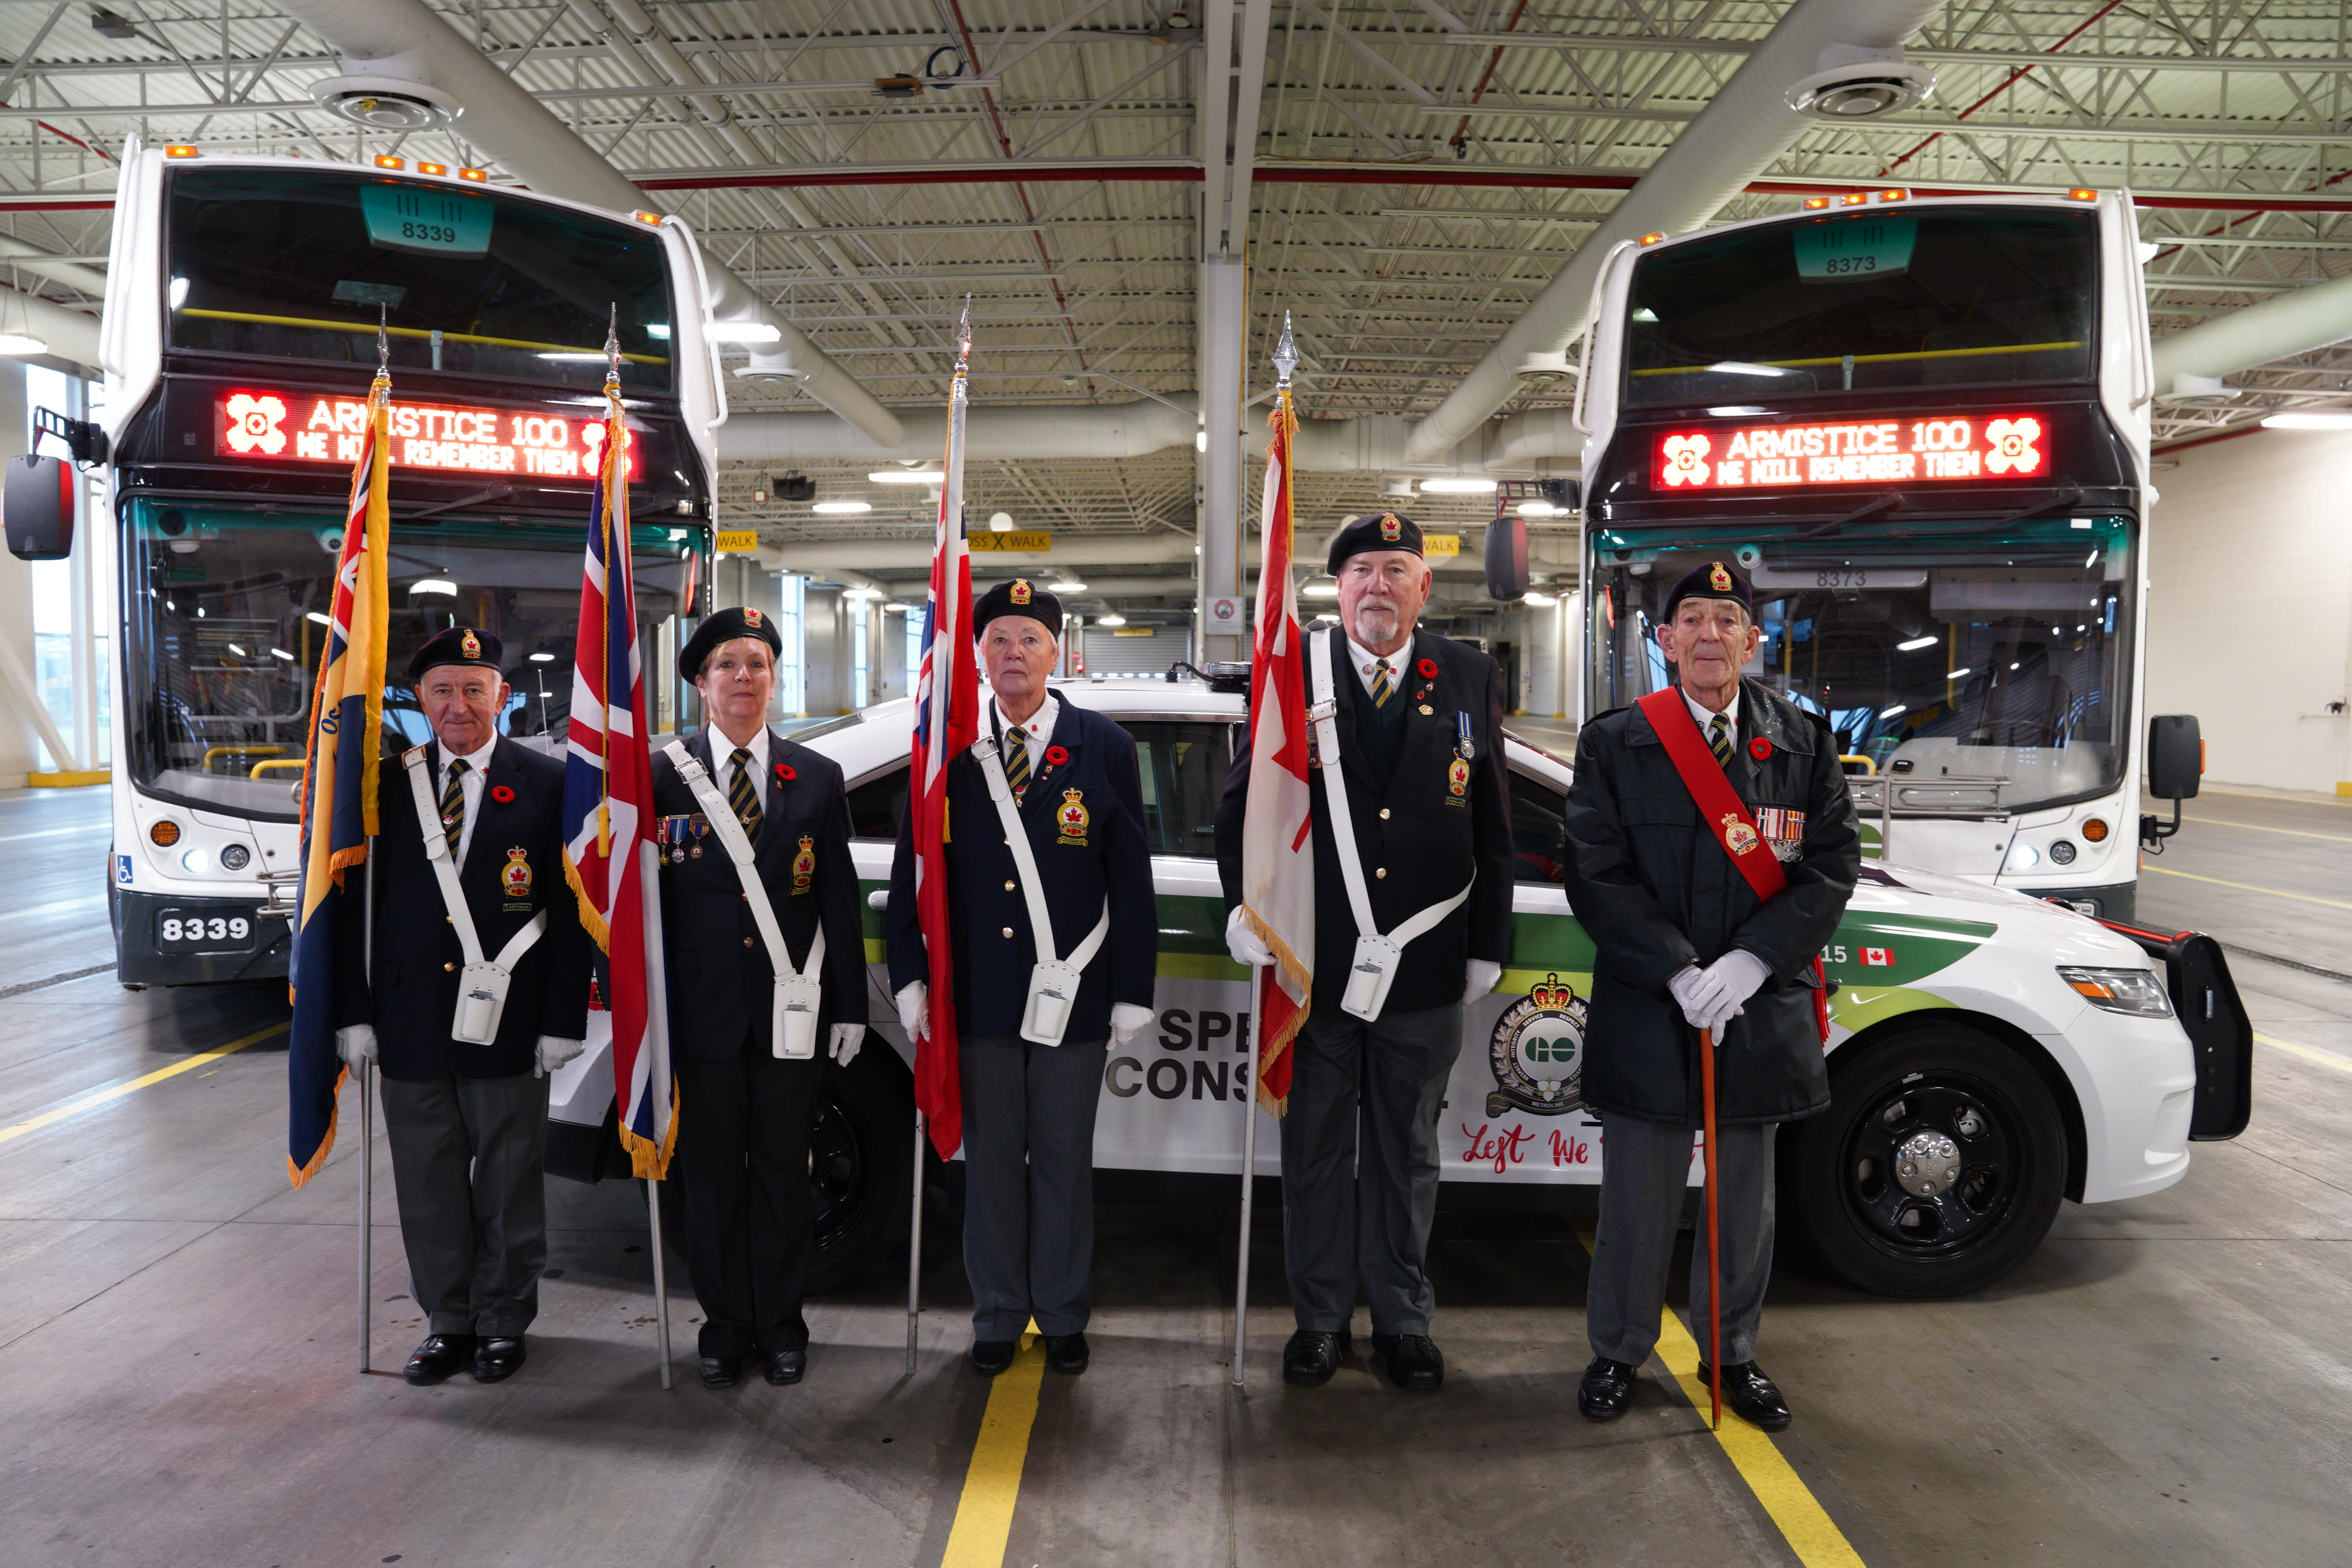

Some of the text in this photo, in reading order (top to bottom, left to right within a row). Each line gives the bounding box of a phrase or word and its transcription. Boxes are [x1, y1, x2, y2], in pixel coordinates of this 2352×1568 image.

[402, 222, 455, 243] 8339
[1827, 256, 1876, 274] 8373
[512, 416, 568, 448] 100
[1727, 421, 1971, 459] ARMISTICE 100
[297, 431, 328, 459] WE
[405, 440, 514, 471] REMEMBER
[523, 448, 577, 476] THEM
[1717, 451, 1980, 485] WE WILL REMEMBER THEM
[718, 535, 752, 547] WALK
[1010, 536, 1046, 547] WALK
[1817, 569, 1866, 587] 8373
[163, 917, 249, 941] 8339
[1821, 945, 1847, 963] 15
[1523, 1013, 1544, 1027] SERVICE
[1559, 1013, 1581, 1029] RESPECT
[1511, 1029, 1521, 1058] INTEGRITY
[1512, 1062, 1529, 1081] RESPECT
[1462, 1123, 1588, 1174] Lest We
